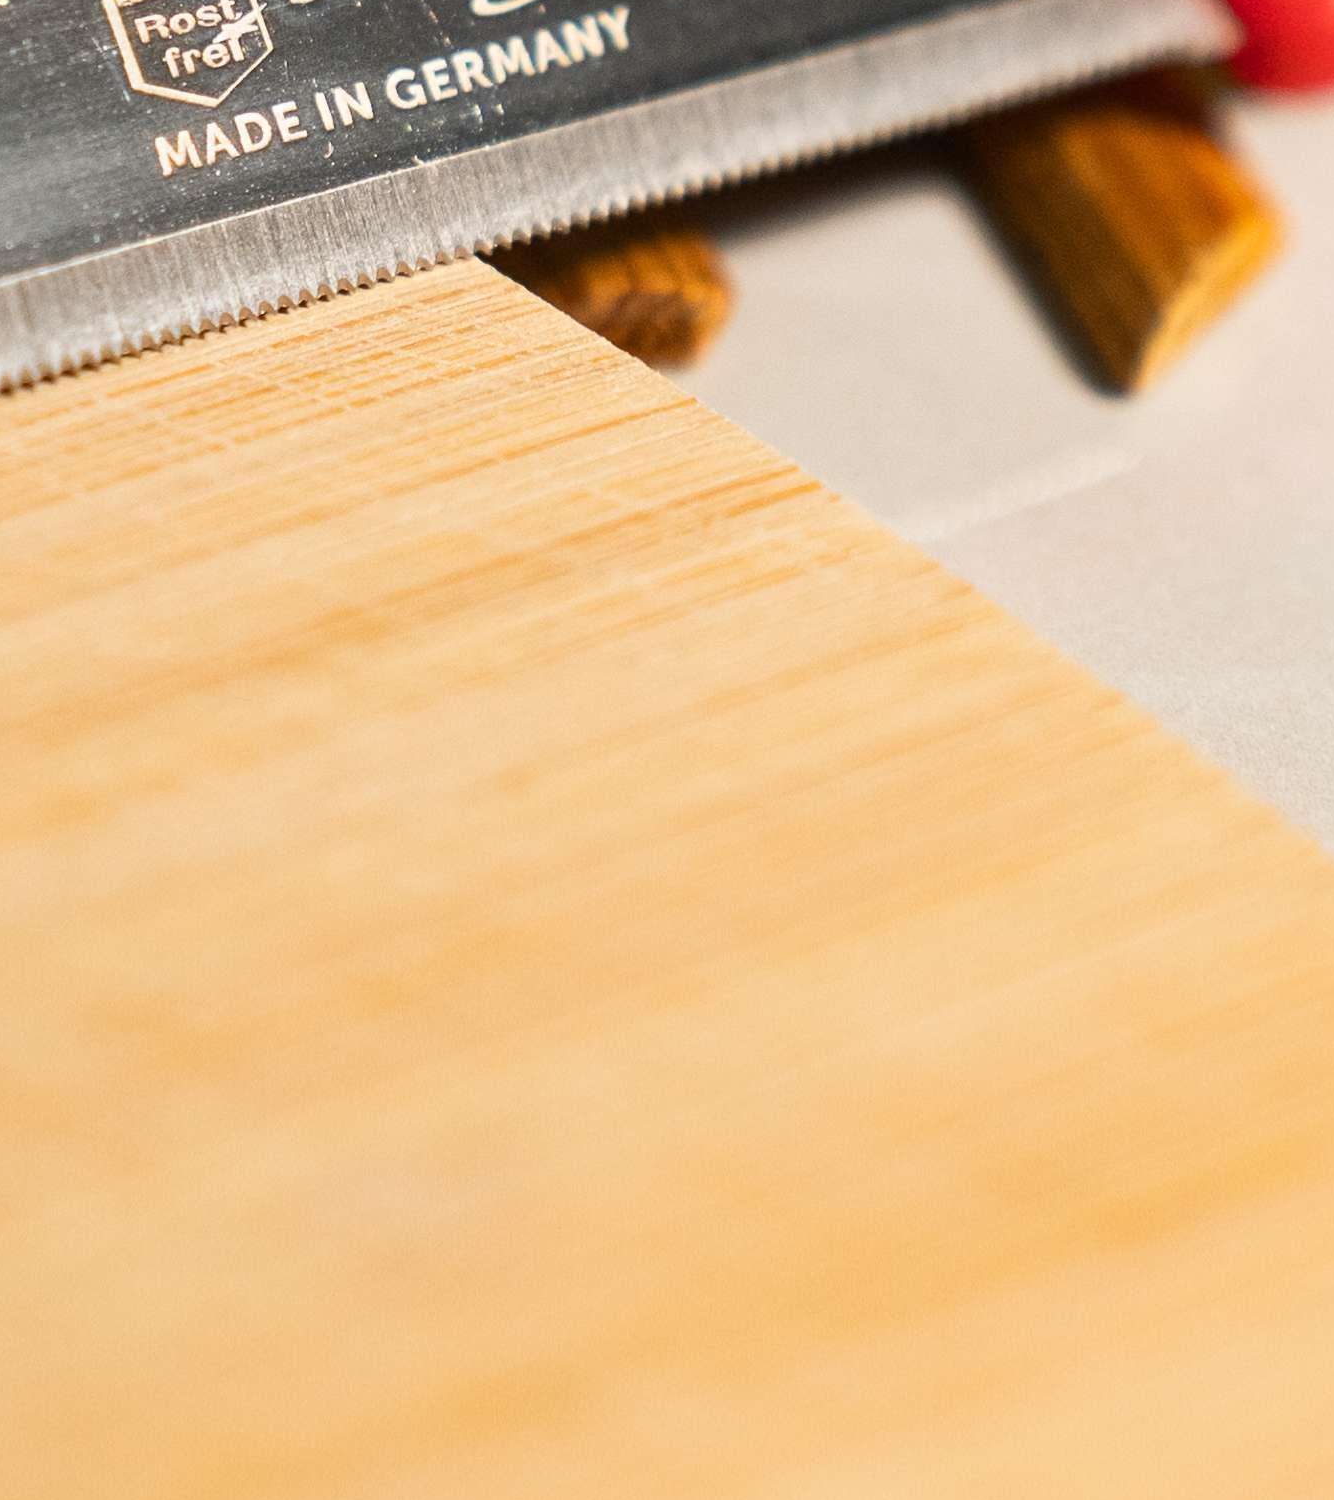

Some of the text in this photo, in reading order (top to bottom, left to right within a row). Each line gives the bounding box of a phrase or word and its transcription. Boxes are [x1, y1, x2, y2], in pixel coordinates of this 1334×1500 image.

[154, 7, 630, 177] MADE IN GERMANY
